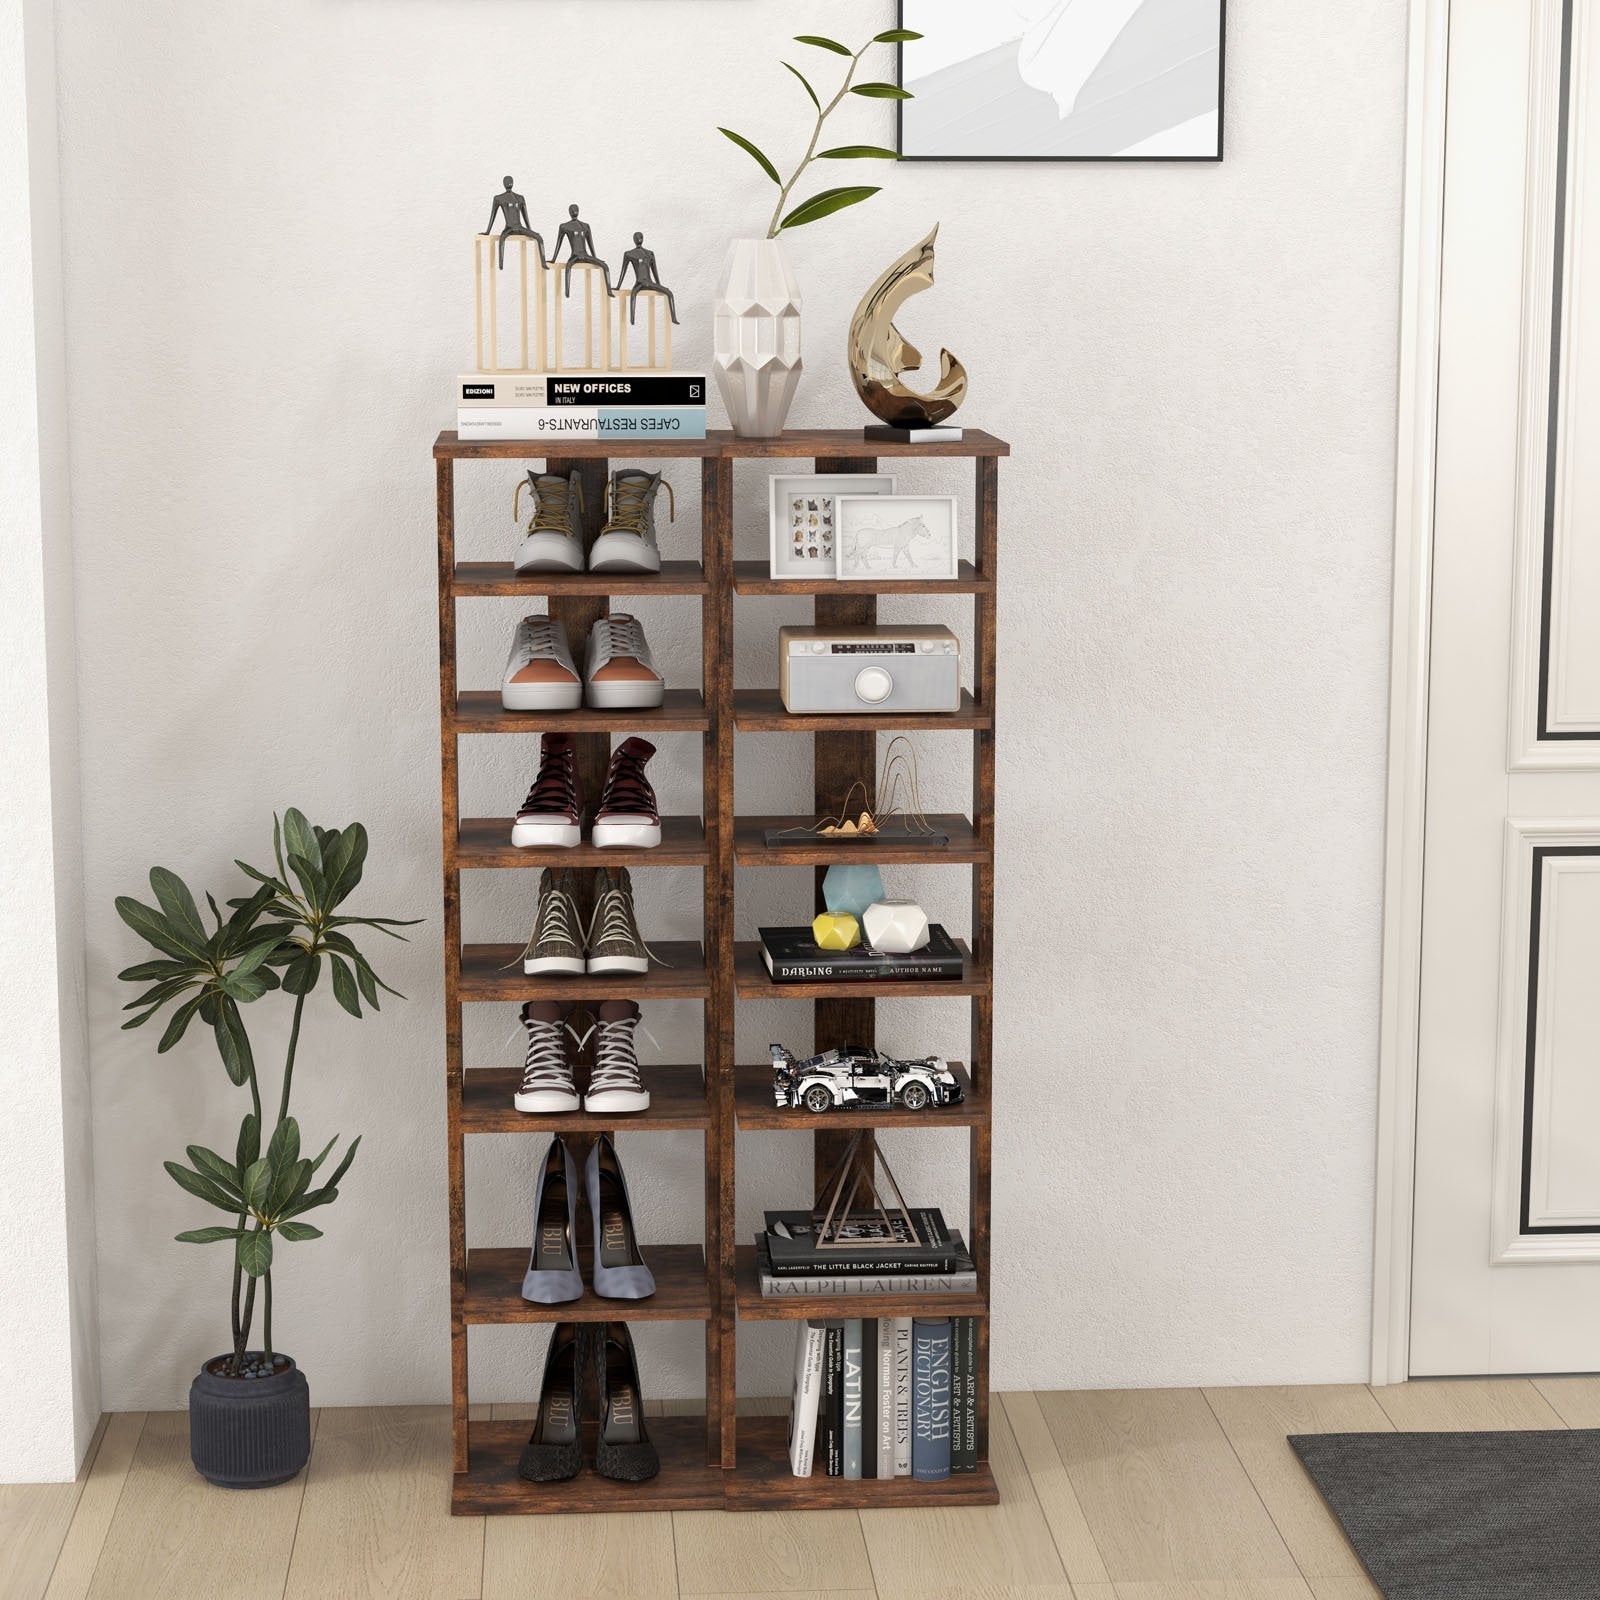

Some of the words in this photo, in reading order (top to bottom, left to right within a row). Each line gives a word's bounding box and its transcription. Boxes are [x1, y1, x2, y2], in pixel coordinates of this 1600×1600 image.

[554, 383, 581, 393] NEW
[583, 383, 632, 393] OFFICES
[555, 396, 561, 404] IN
[562, 396, 576, 404] ITALY
[538, 418, 637, 431] RESTAURANTS-6
[640, 418, 681, 431] CAFES
[781, 967, 833, 977] DARLING
[852, 1262, 875, 1270] BLACK
[768, 1280, 848, 1294] RALPH
[858, 1278, 953, 1293] LAUREN
[897, 1329, 909, 1383] PLANTS
[814, 1362, 822, 1372] type
[883, 1349, 892, 1387] Norman
[845, 1348, 862, 1421] LATIN
[897, 1385, 909, 1395] &
[917, 1337, 931, 1441] DICTIONARY
[931, 1337, 949, 1440] ENGLISH
[953, 1374, 961, 1396] ART
[966, 1374, 975, 1396] ART
[883, 1390, 892, 1419] Foster
[953, 1397, 961, 1407] &
[966, 1397, 975, 1407] &
[882, 1421, 890, 1433] on
[897, 1399, 909, 1444] TREES
[953, 1408, 961, 1451] ARTISTS
[966, 1408, 975, 1451] ARTISTS
[882, 1435, 892, 1450] Art
